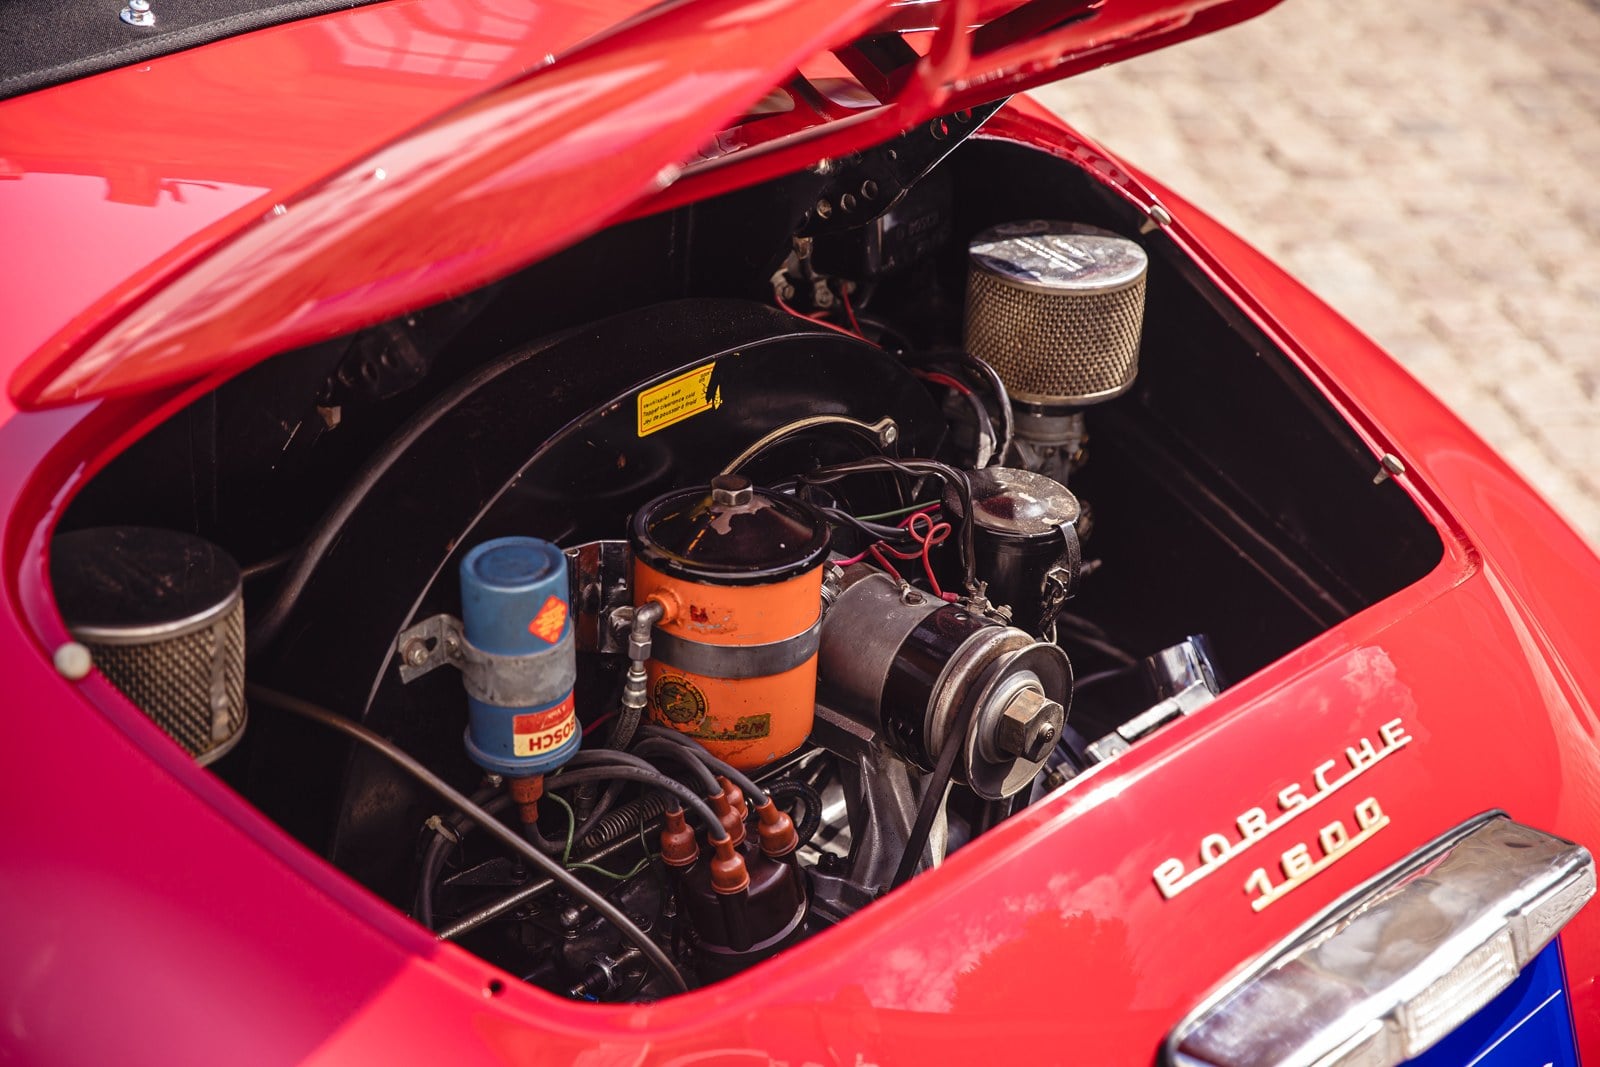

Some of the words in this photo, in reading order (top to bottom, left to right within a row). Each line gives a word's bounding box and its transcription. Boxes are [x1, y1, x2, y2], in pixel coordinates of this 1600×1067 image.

[529, 715, 575, 752] BOSCH
[1153, 717, 1413, 900] PORSCHE
[1243, 796, 1391, 912] 1600
